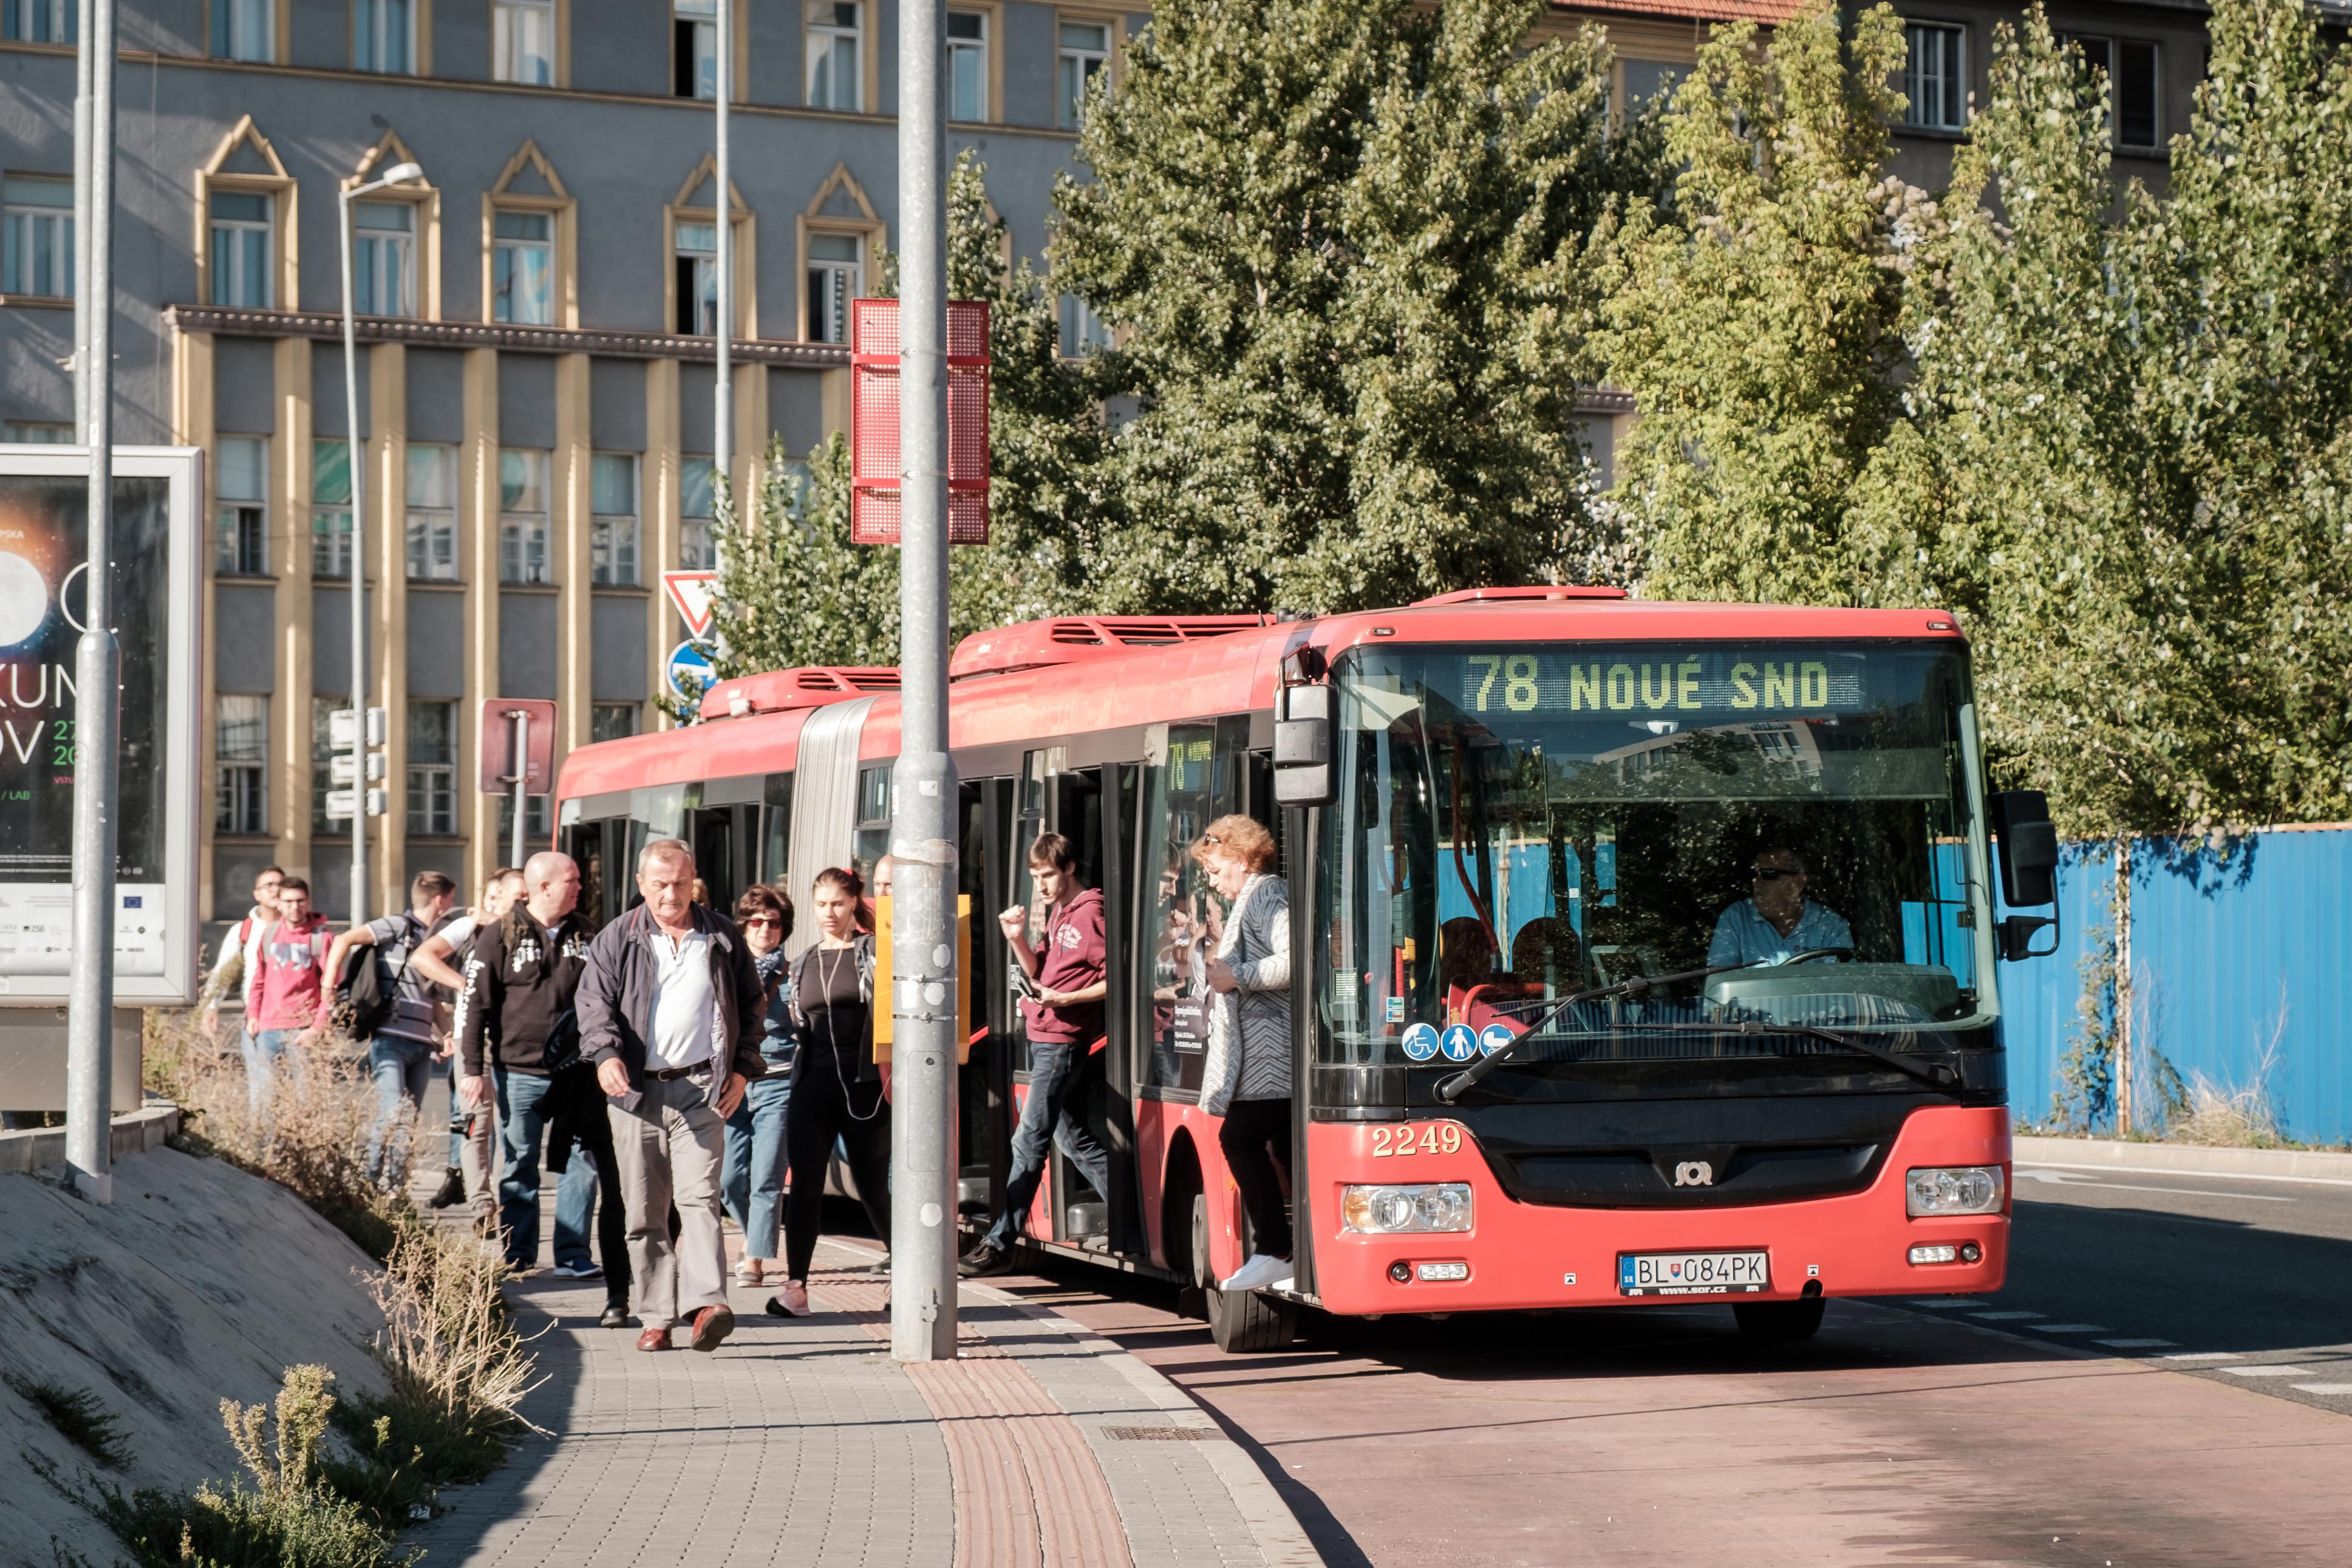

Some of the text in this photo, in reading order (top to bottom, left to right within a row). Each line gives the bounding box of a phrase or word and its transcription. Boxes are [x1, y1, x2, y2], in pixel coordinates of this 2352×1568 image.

[1468, 654, 1827, 711] 78 NOVÉ SND
[0, 720, 45, 765] V
[10, 791, 30, 800] LAB
[1372, 1125, 1462, 1157] 2249
[1640, 1256, 1761, 1283] BL 084PK
[1659, 1286, 1727, 1295] www.sor.cz
